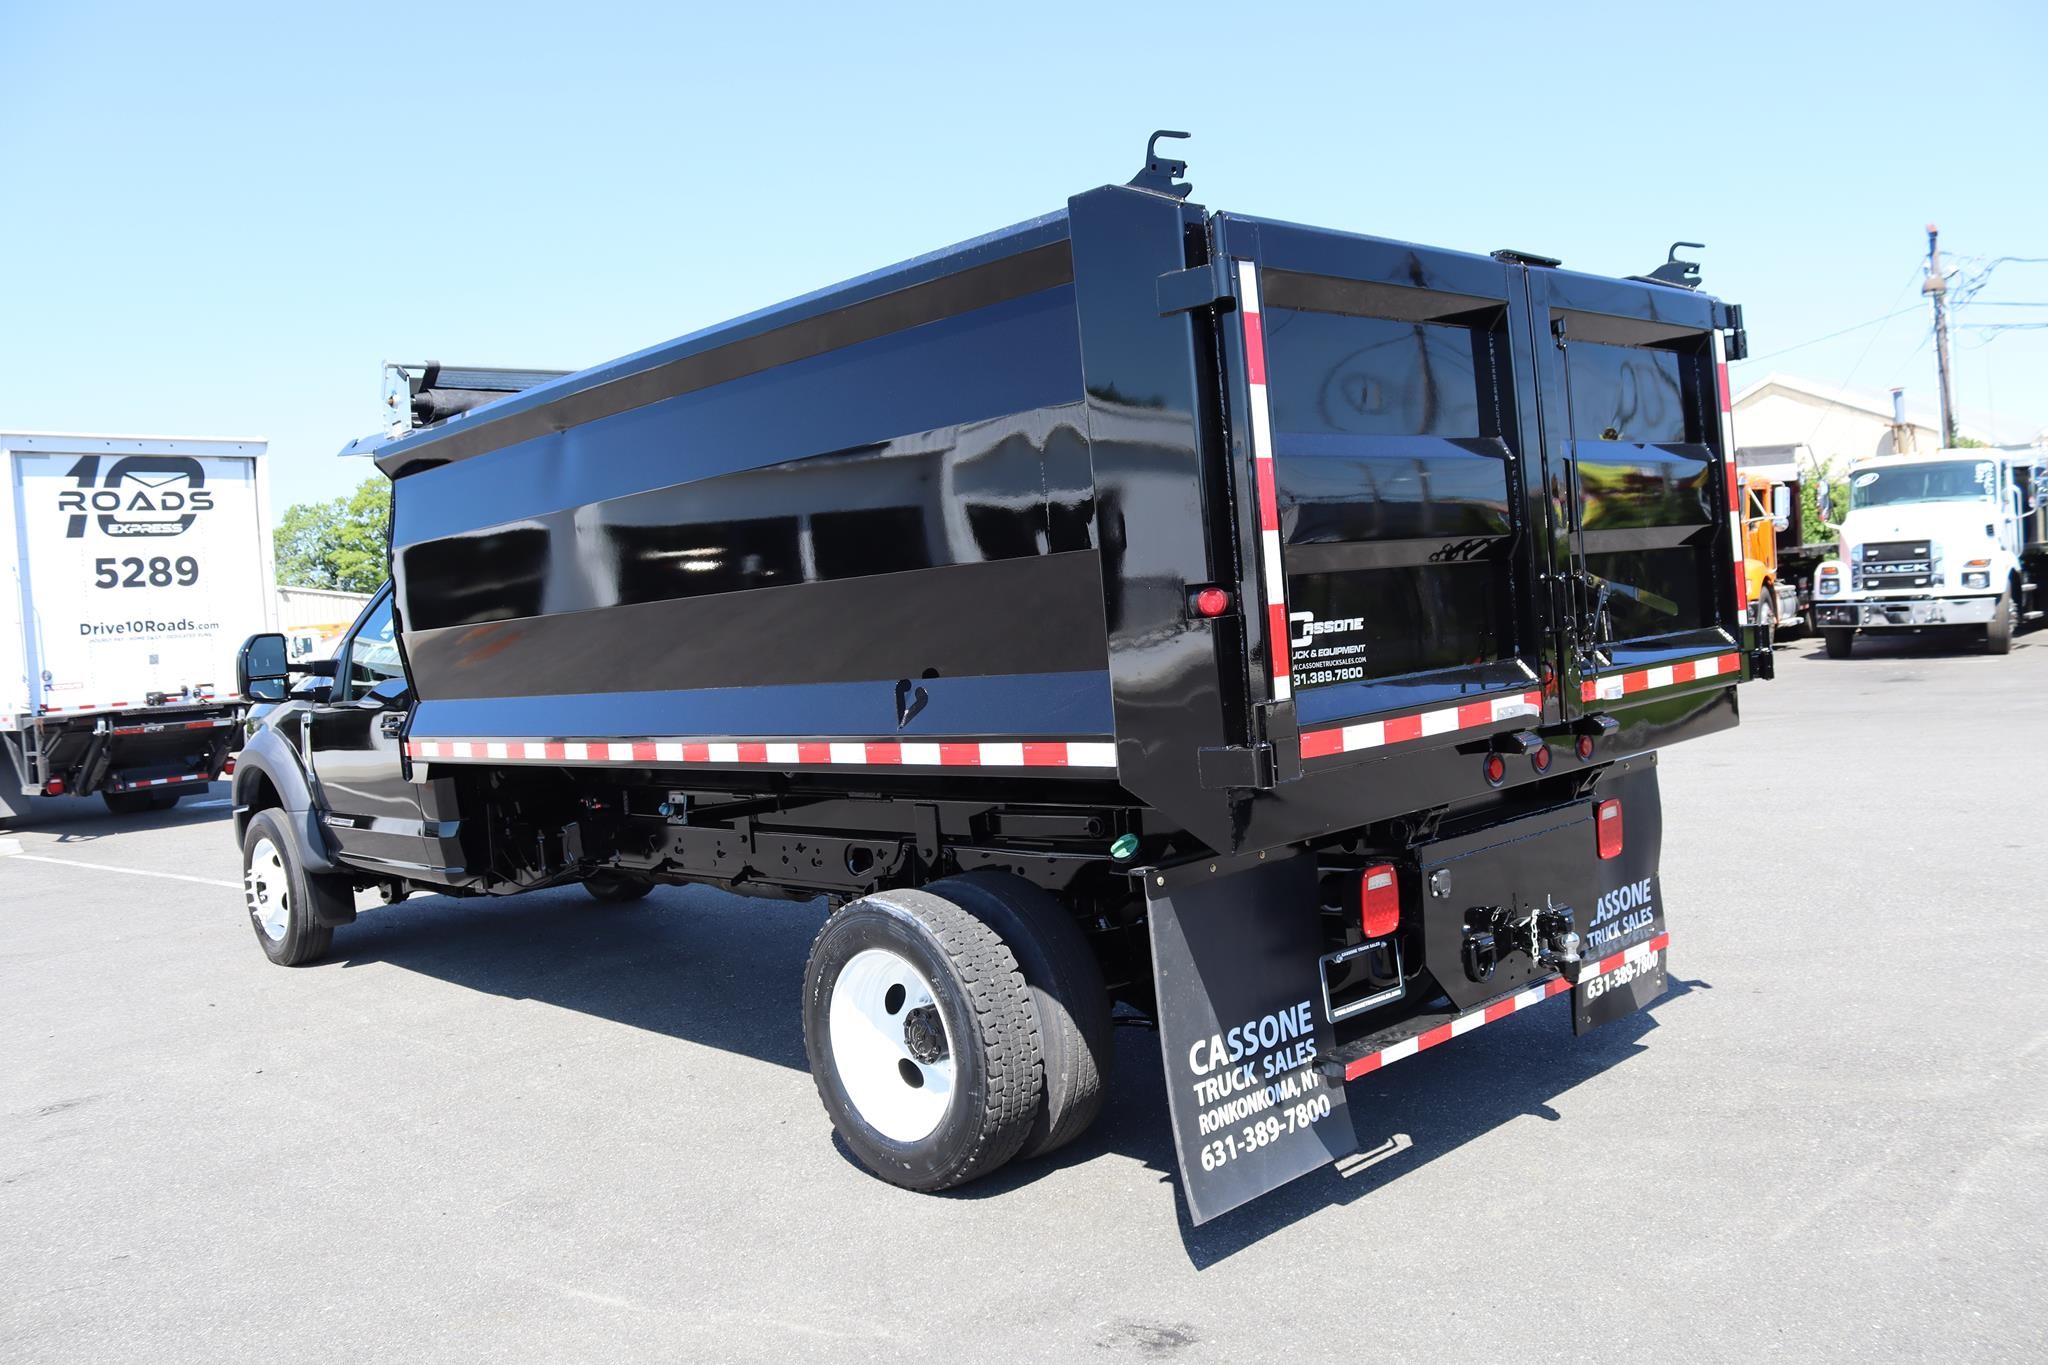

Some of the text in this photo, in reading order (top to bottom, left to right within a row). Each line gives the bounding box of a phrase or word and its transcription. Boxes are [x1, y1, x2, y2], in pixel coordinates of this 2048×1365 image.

[58, 491, 214, 511] ROADS
[108, 523, 183, 534] EXPRESS
[95, 556, 199, 589] 5289
[1864, 563, 1929, 574] MACK
[80, 618, 219, 636] Drive10Roads.com
[1292, 644, 1366, 660] UCK & EQUIPMENT
[1294, 667, 1363, 686] 31.389.7800
[1590, 878, 1651, 927] ASSONE
[1587, 907, 1653, 947] TRUCK SALES
[1587, 949, 1659, 999] 631-389-7800
[1189, 1000, 1314, 1076] CASSONE
[1193, 1038, 1318, 1107] TRUCK SALES
[1199, 1068, 1320, 1137] RONKONKOMA, NY
[1201, 1094, 1331, 1172] 631-389-7800
